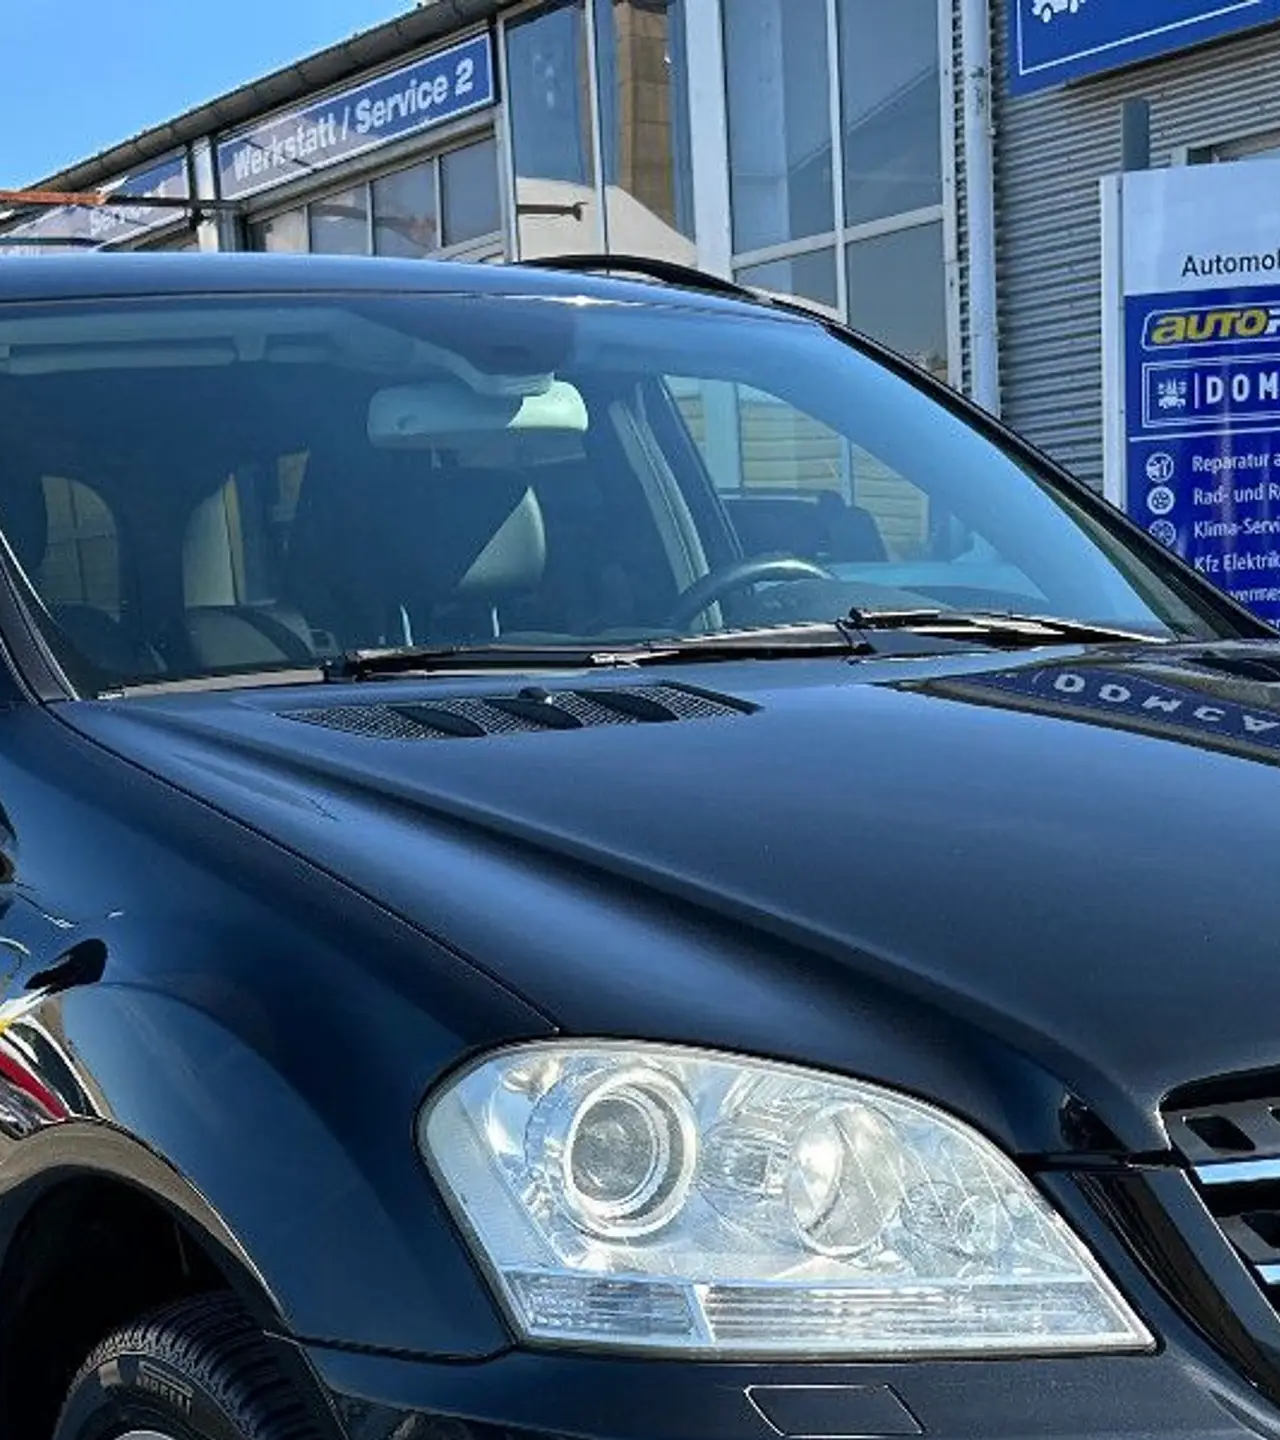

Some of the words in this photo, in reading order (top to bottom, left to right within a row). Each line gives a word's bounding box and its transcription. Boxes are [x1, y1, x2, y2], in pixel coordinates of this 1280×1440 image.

[232, 115, 336, 182] Werkstatt
[355, 75, 449, 134] Service
[455, 58, 475, 98] 2
[1192, 452, 1270, 475] Reparatur
[1193, 485, 1230, 506] Rad-
[1233, 481, 1265, 503] und
[1194, 554, 1220, 574] Kfz
[1223, 549, 1280, 572] Elektrik
